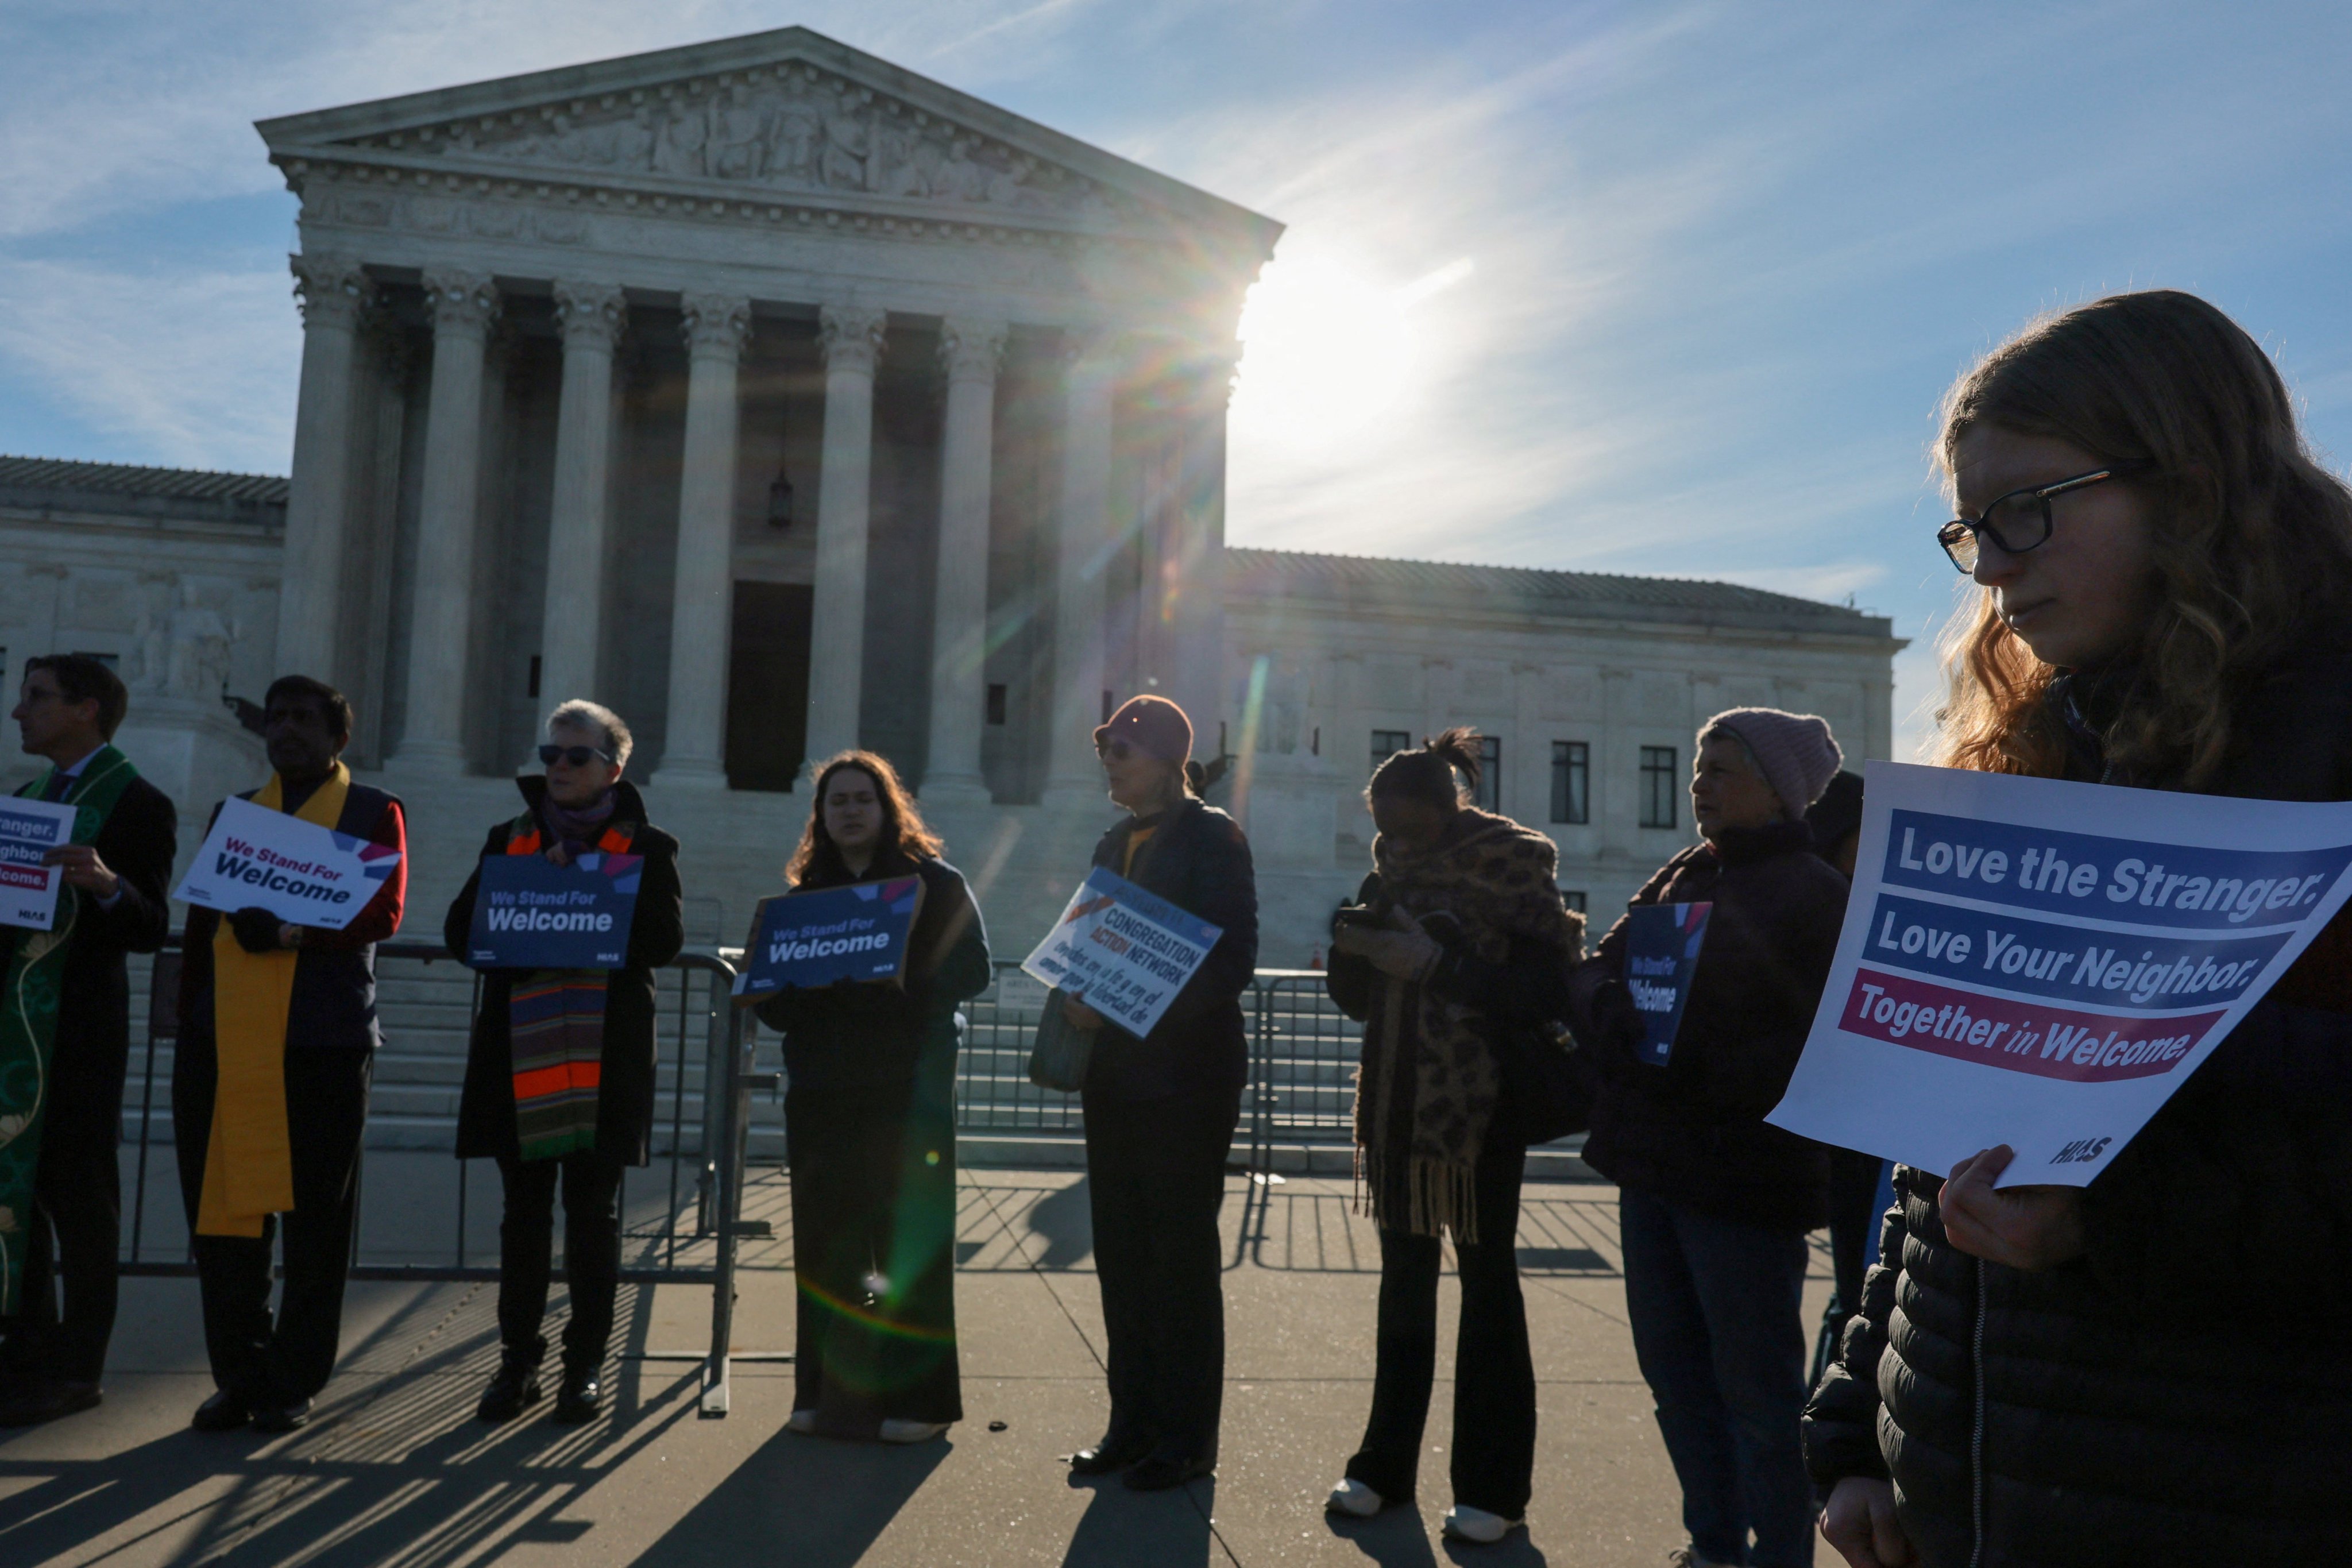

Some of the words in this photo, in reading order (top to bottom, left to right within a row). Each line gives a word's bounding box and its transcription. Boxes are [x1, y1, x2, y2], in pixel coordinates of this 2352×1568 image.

[215, 852, 350, 904] Welcome
[226, 837, 253, 857] We
[257, 847, 312, 875] Stand
[311, 863, 343, 882] For
[1899, 827, 2008, 883] Love
[2018, 847, 2099, 897] the
[2106, 858, 2325, 922] Stranger.
[488, 907, 613, 932] Welcome
[491, 891, 516, 905] We
[518, 891, 568, 905] Stand
[569, 890, 597, 905] For
[770, 932, 890, 964] Welcome
[773, 929, 798, 941] We
[801, 920, 847, 939] Stand
[848, 918, 876, 932] For
[1104, 907, 1202, 969] CONGREGATION
[1090, 925, 1133, 956] ACTION
[1126, 944, 1188, 987] NETWORK
[1878, 910, 1971, 963] Love
[1983, 930, 2075, 982] Your
[2071, 946, 2259, 1003] Neighbor.
[1129, 1006, 1149, 1025] de
[1859, 983, 2010, 1038] Together
[2004, 1020, 2040, 1056] in
[2040, 1022, 2191, 1067] Welcome.
[2049, 1137, 2112, 1165] HIAS
